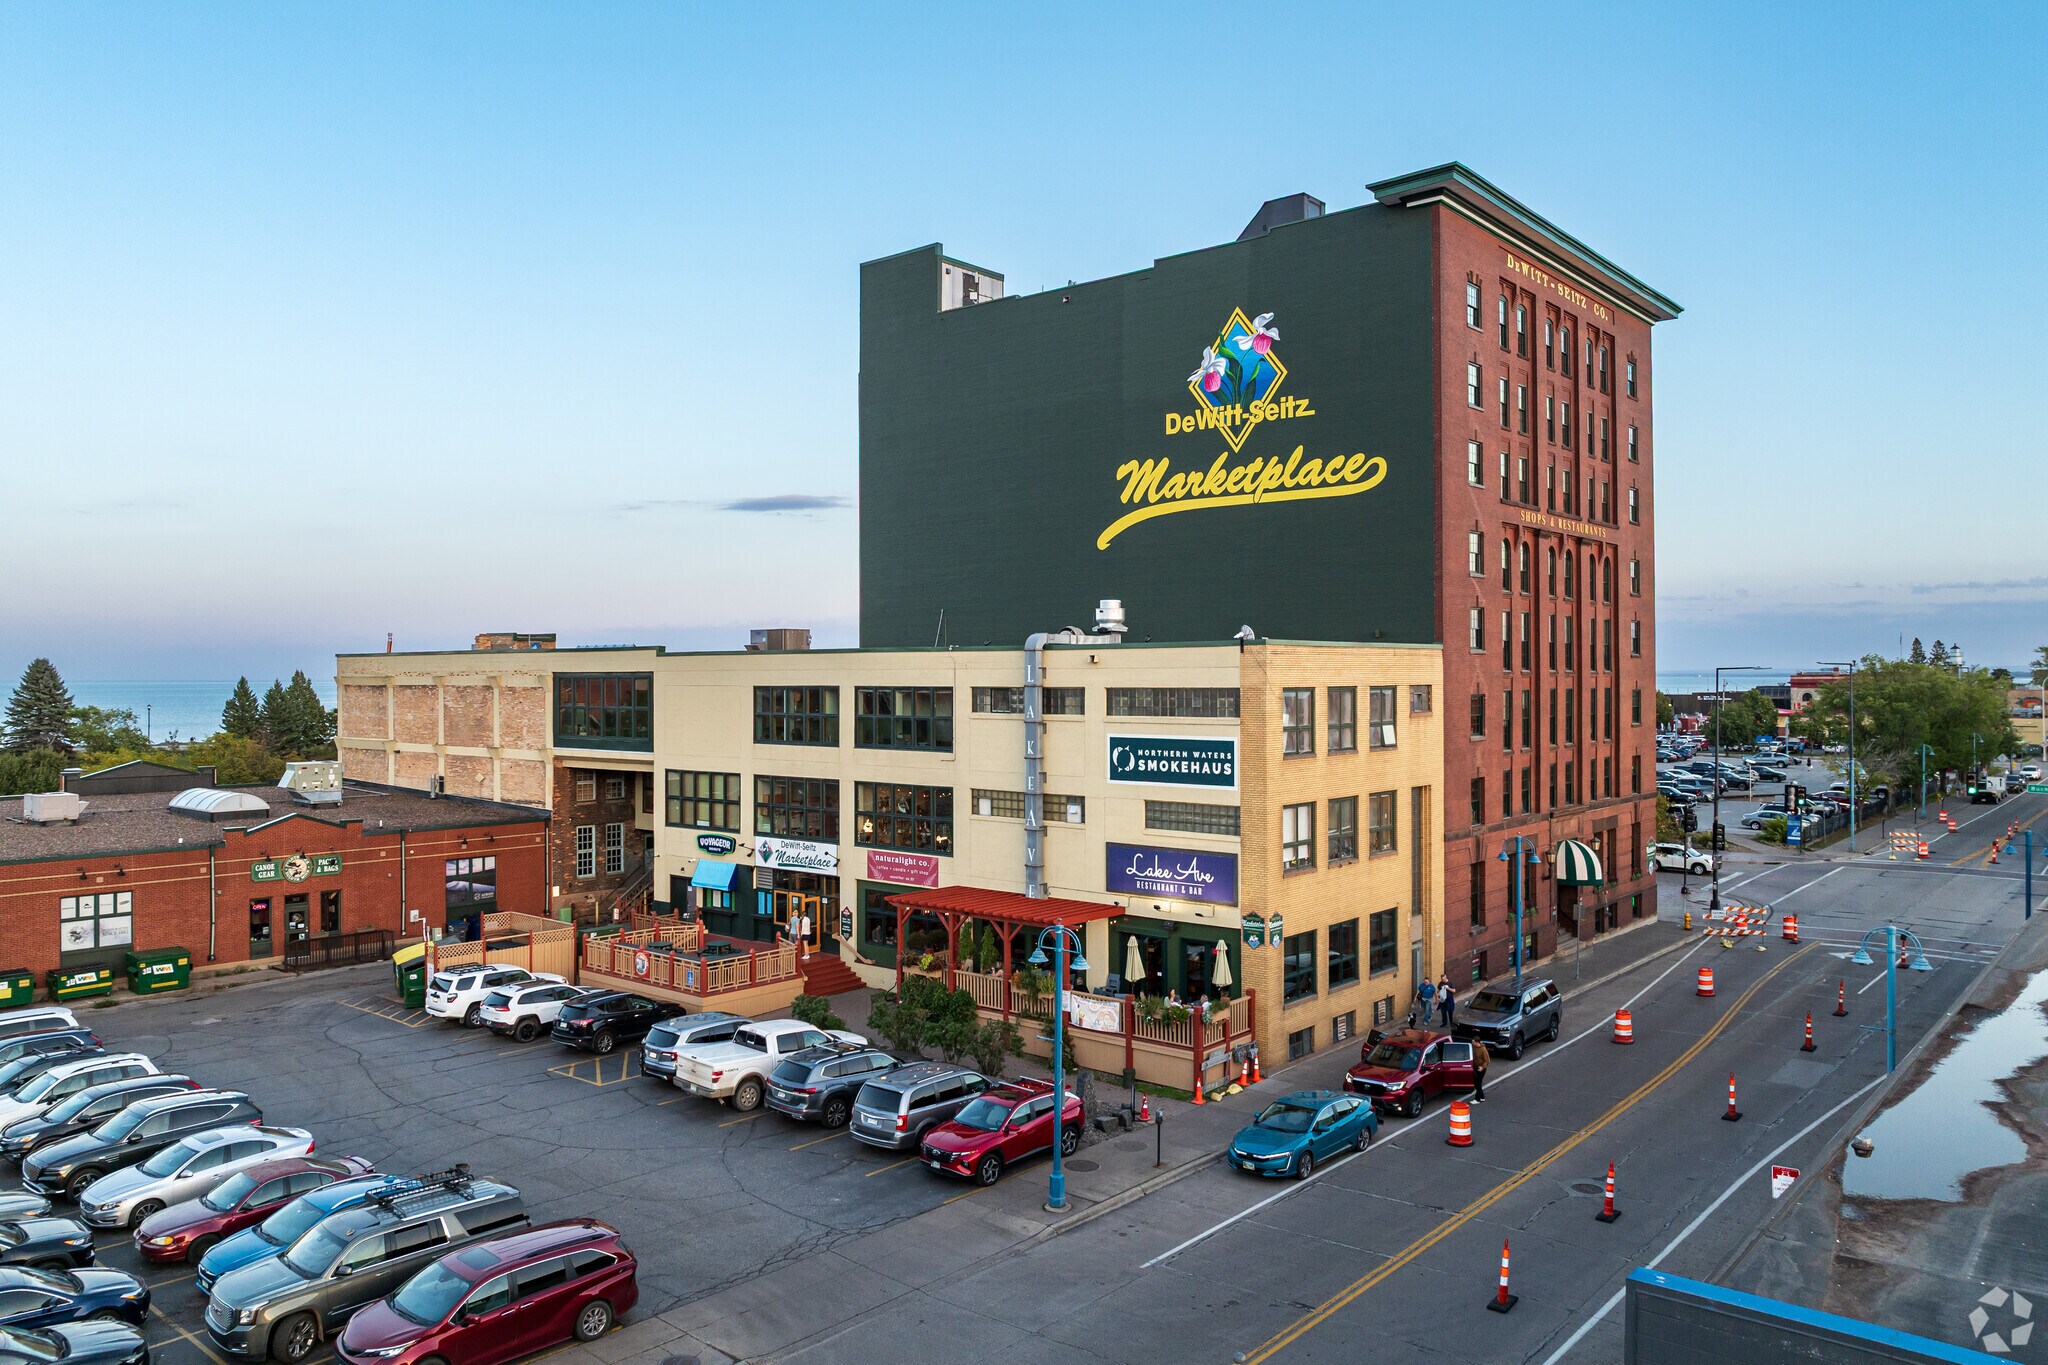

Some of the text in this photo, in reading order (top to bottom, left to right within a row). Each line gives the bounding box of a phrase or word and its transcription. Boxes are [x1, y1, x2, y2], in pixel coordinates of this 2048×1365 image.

[1593, 304, 1608, 320] CO.
[1166, 396, 1316, 435] DeWitt-Seitz
[1116, 445, 1387, 504] Marketplace
[1520, 510, 1606, 538] SHOPS & RESTAURANTS
[1138, 749, 1232, 760] NORTHERN WATERS
[1138, 759, 1232, 775] SMOKEHAUS
[700, 837, 731, 850] VOYAGEUR
[781, 840, 816, 852] DeWitt-Seitz
[775, 849, 831, 868] Marketplace
[875, 855, 916, 866] naturalight
[255, 863, 275, 871] CANOE
[258, 870, 275, 878] GEAR
[1126, 853, 1214, 883] Lake Ave
[1136, 881, 1203, 895] RESTAURANT & BAR
[252, 902, 268, 910] OPEN
